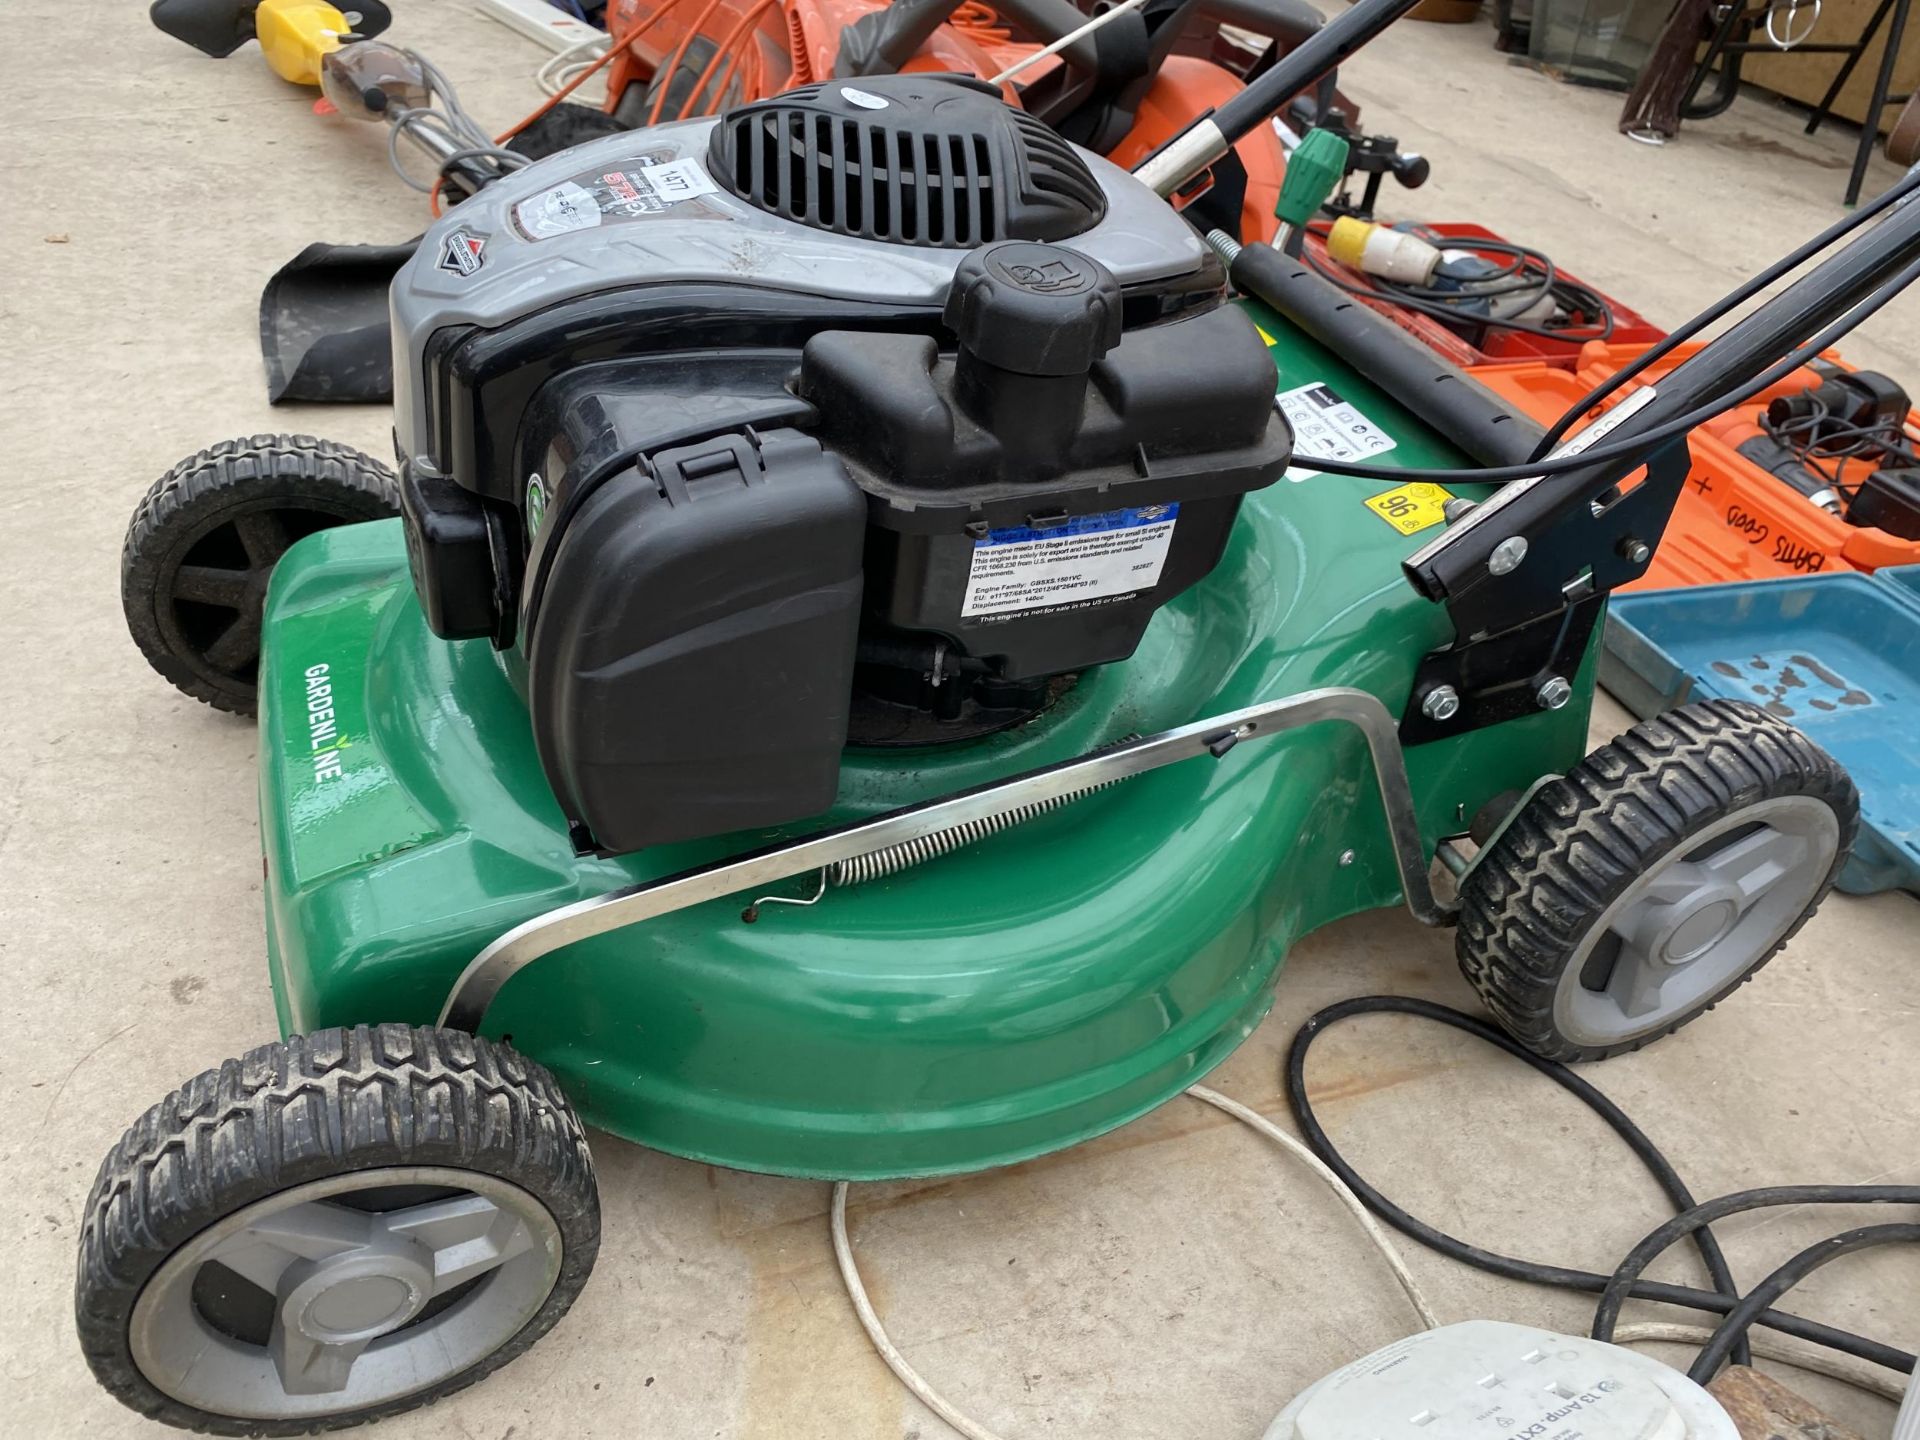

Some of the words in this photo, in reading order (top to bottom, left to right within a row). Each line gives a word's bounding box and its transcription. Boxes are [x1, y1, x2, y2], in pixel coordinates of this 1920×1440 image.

[660, 170, 690, 191] 1477
[1378, 495, 1418, 518] 96
[989, 555, 1011, 564] engine
[1048, 548, 1069, 556] export
[1070, 545, 1082, 553] and
[1089, 541, 1116, 550] therefore
[1140, 534, 1156, 542] under
[990, 548, 1012, 556] engine
[1046, 541, 1063, 549] Stage
[1069, 537, 1100, 545] emissions
[1047, 554, 1078, 563] emissions
[1080, 549, 1110, 559] standards
[1123, 544, 1143, 552] related
[1772, 535, 1826, 573] BATTS
[976, 586, 1000, 594] Engine
[972, 598, 1021, 609] Displacement:
[997, 612, 1022, 621] engine
[1113, 592, 1137, 602] Canada
[304, 663, 343, 783] GARDENLINE
[1580, 1392, 1601, 1404] 13
